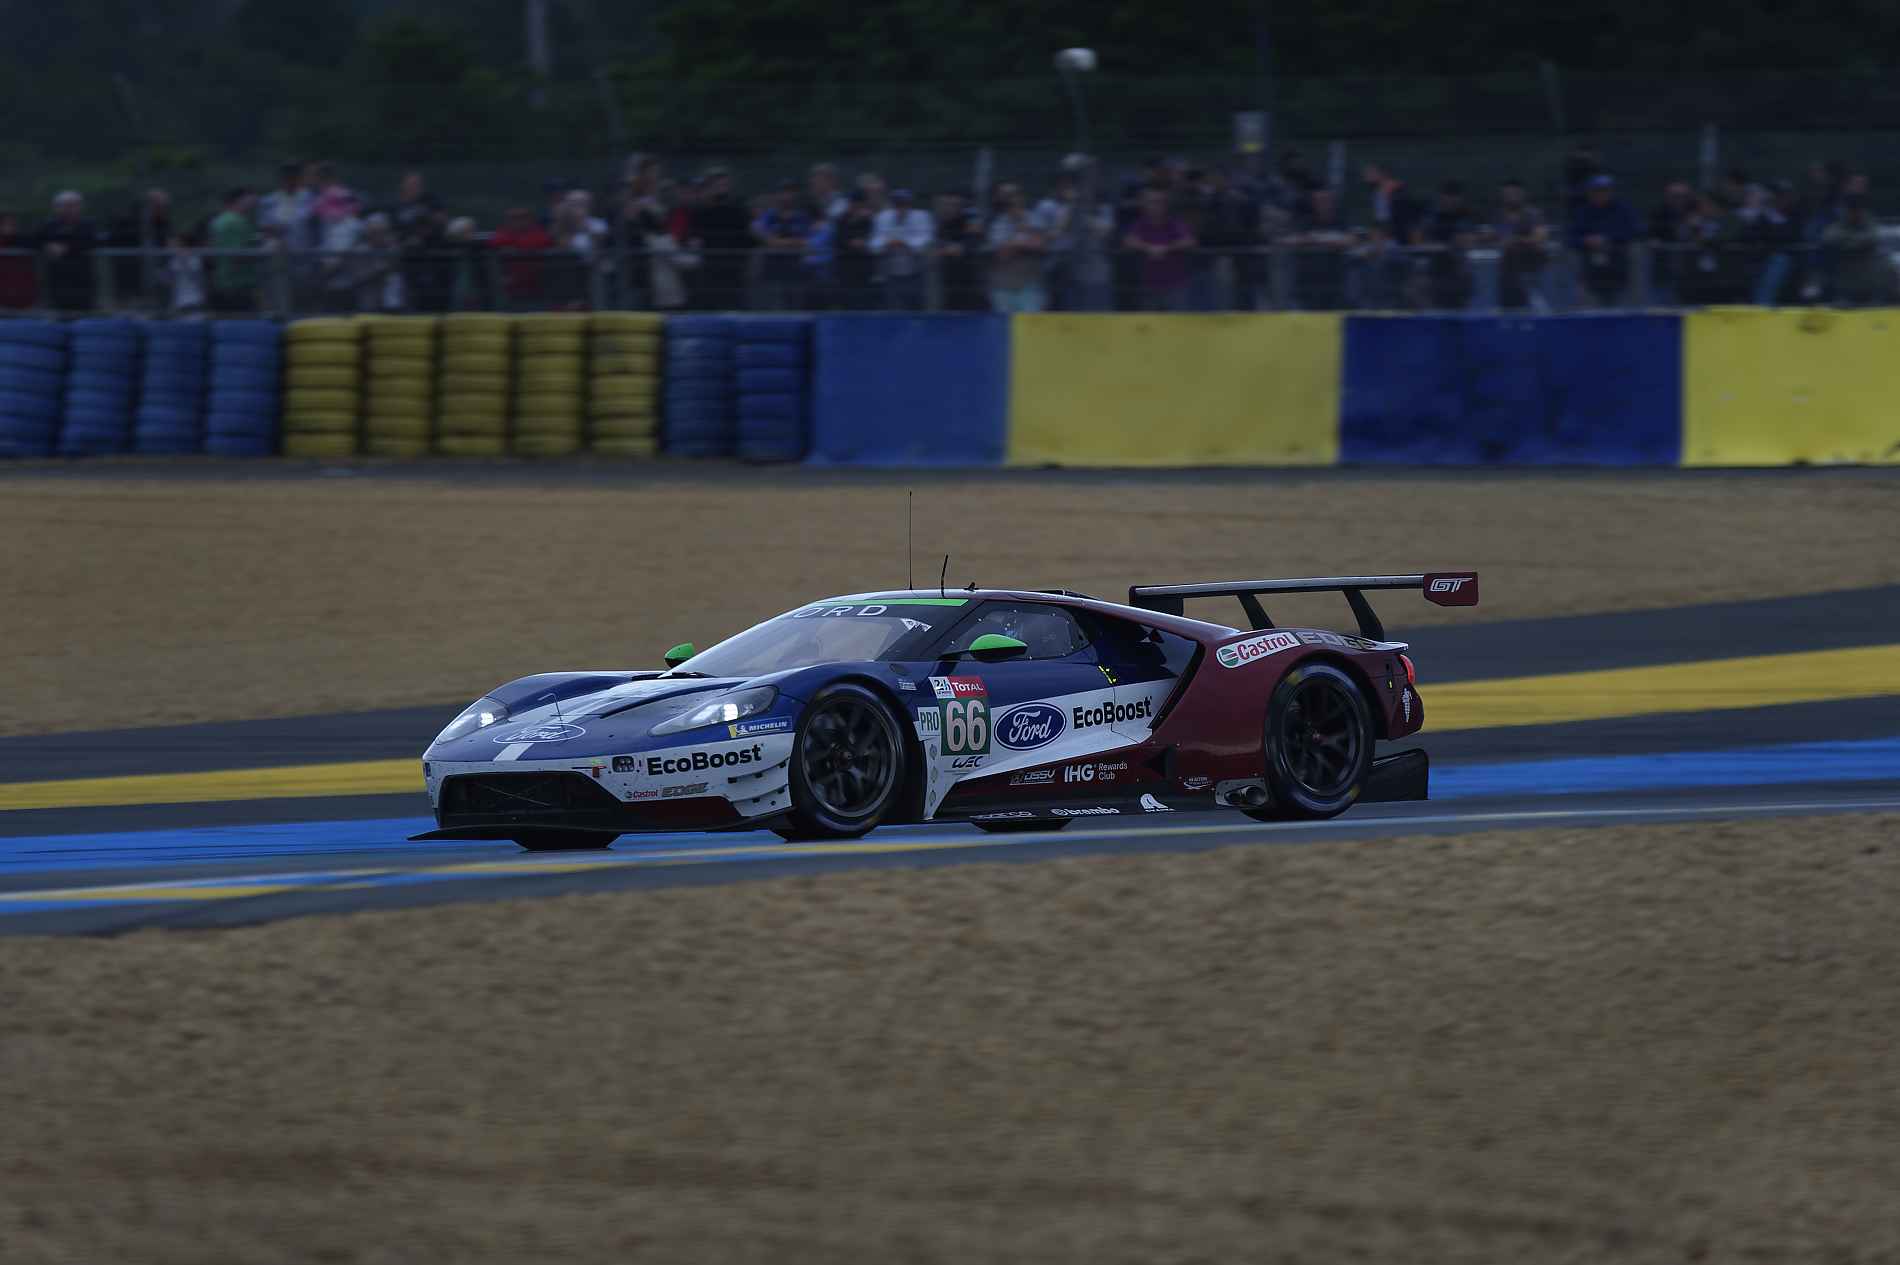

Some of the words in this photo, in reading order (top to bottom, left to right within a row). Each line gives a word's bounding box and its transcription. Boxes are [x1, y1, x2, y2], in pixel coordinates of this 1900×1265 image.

[1430, 577, 1473, 593] GT
[793, 605, 888, 618] ORD
[1237, 634, 1295, 660] Castrol
[919, 711, 940, 732] PRO
[1073, 697, 1152, 729] EcoBoost
[748, 720, 788, 732] MICHELIN
[946, 699, 987, 753] 66
[1008, 710, 1053, 744] Ford
[647, 744, 763, 776] EcoBoost
[952, 756, 984, 769] WEC
[1098, 760, 1128, 771] Rewards
[1064, 763, 1095, 783] IHG
[1098, 770, 1116, 781] Club
[633, 789, 658, 799] Castrol
